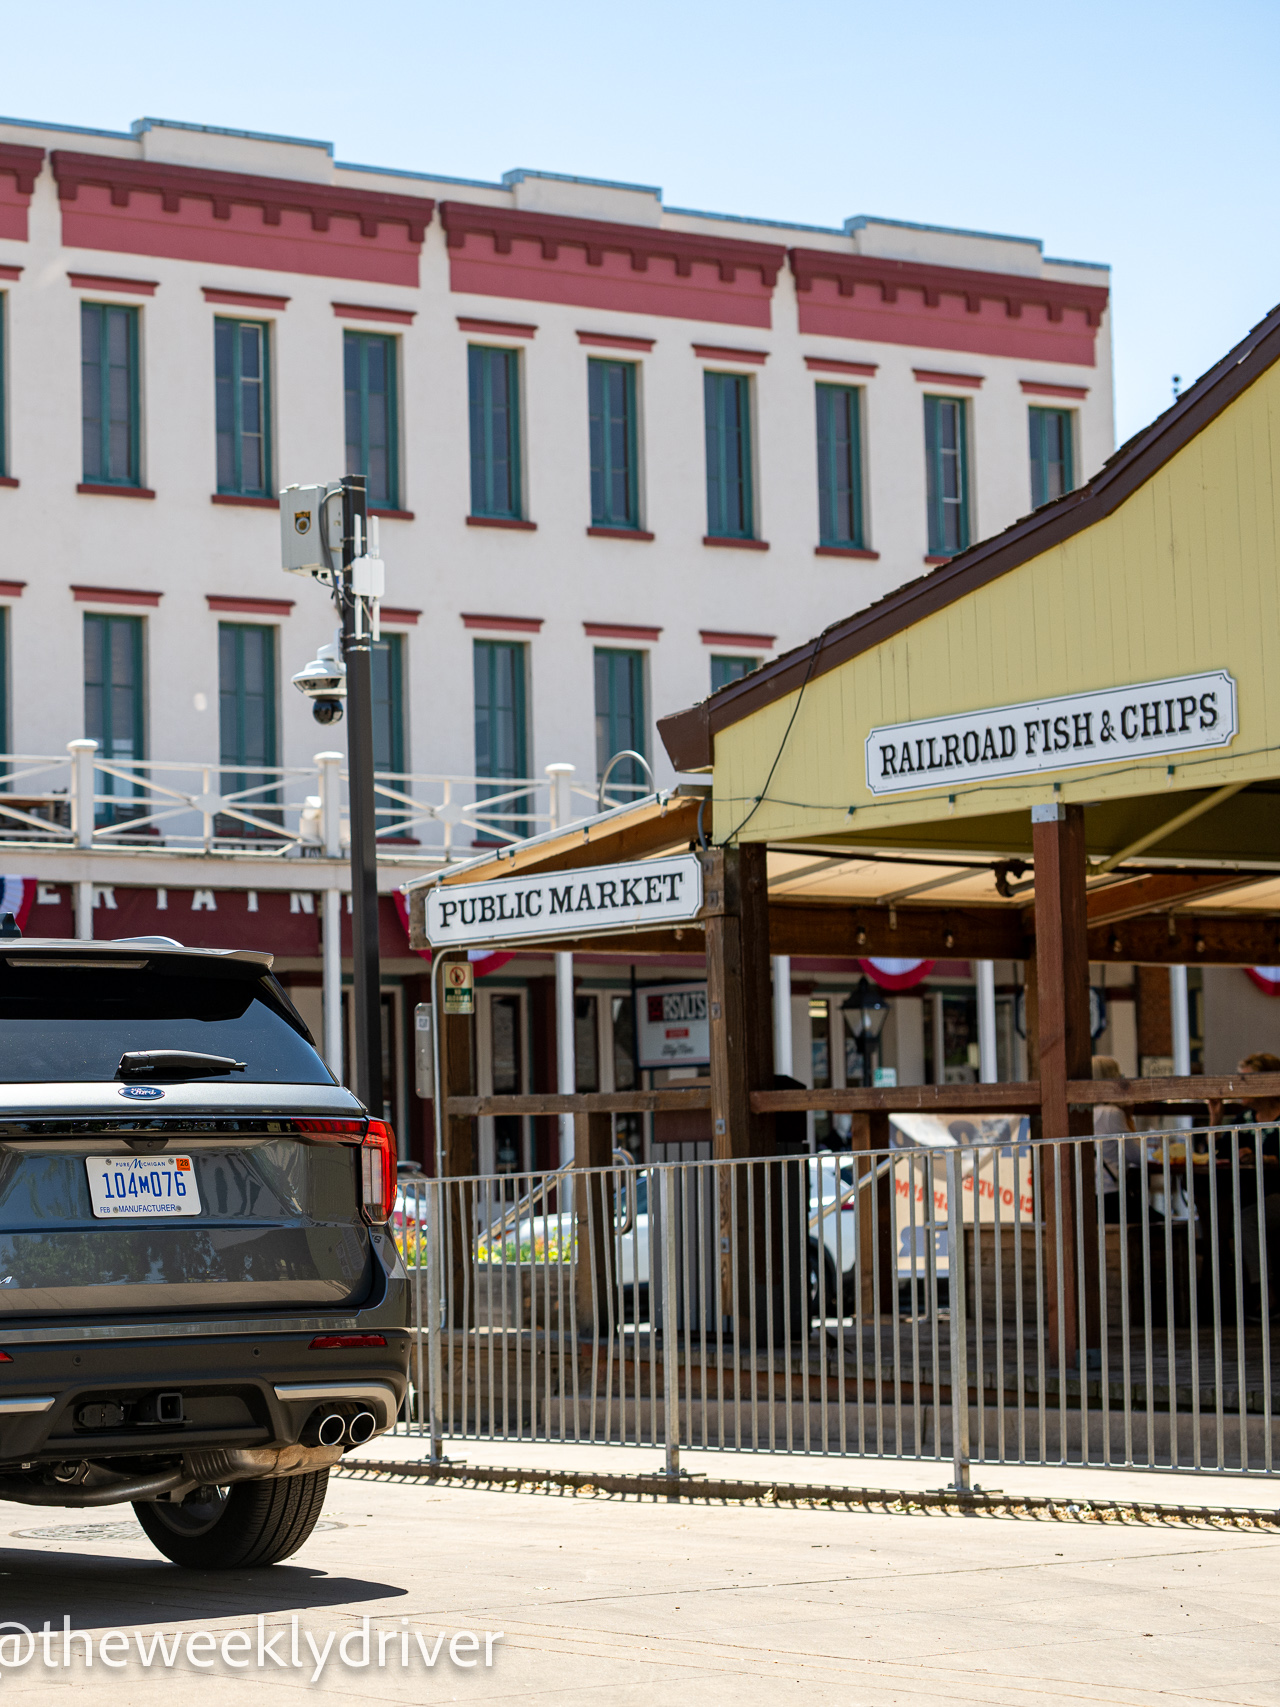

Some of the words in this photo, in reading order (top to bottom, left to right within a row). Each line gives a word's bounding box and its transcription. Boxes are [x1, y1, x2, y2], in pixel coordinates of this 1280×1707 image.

[879, 724, 1017, 778] RAILROAD
[1025, 712, 1094, 757] FISH
[1100, 709, 1117, 742] &
[1121, 692, 1218, 740] CHIPS
[439, 889, 542, 928] PUBLIC
[549, 872, 684, 915] MARKET
[130, 1087, 157, 1096] Ford
[102, 1171, 187, 1199] 104M076
[100, 1206, 111, 1214] FEB
[118, 1203, 177, 1213] MANUFACTURER
